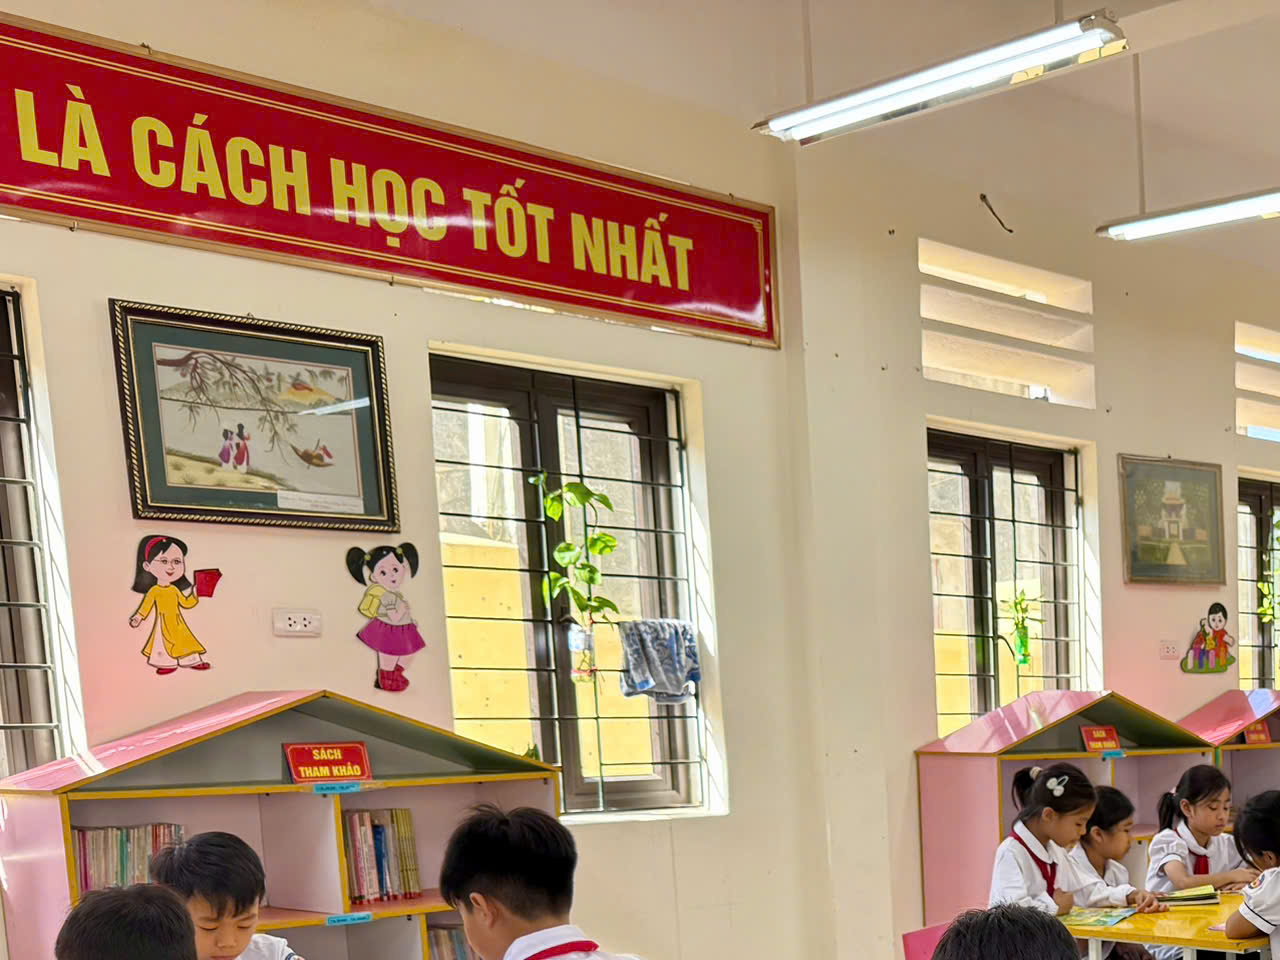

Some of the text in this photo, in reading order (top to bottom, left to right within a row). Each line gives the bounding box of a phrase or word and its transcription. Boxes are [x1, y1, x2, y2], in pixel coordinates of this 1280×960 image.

[15, 84, 695, 293] LÀ CÁCH HỌC TỐT NHẤT
[312, 746, 342, 761] SÁCH
[298, 766, 330, 778] THAM
